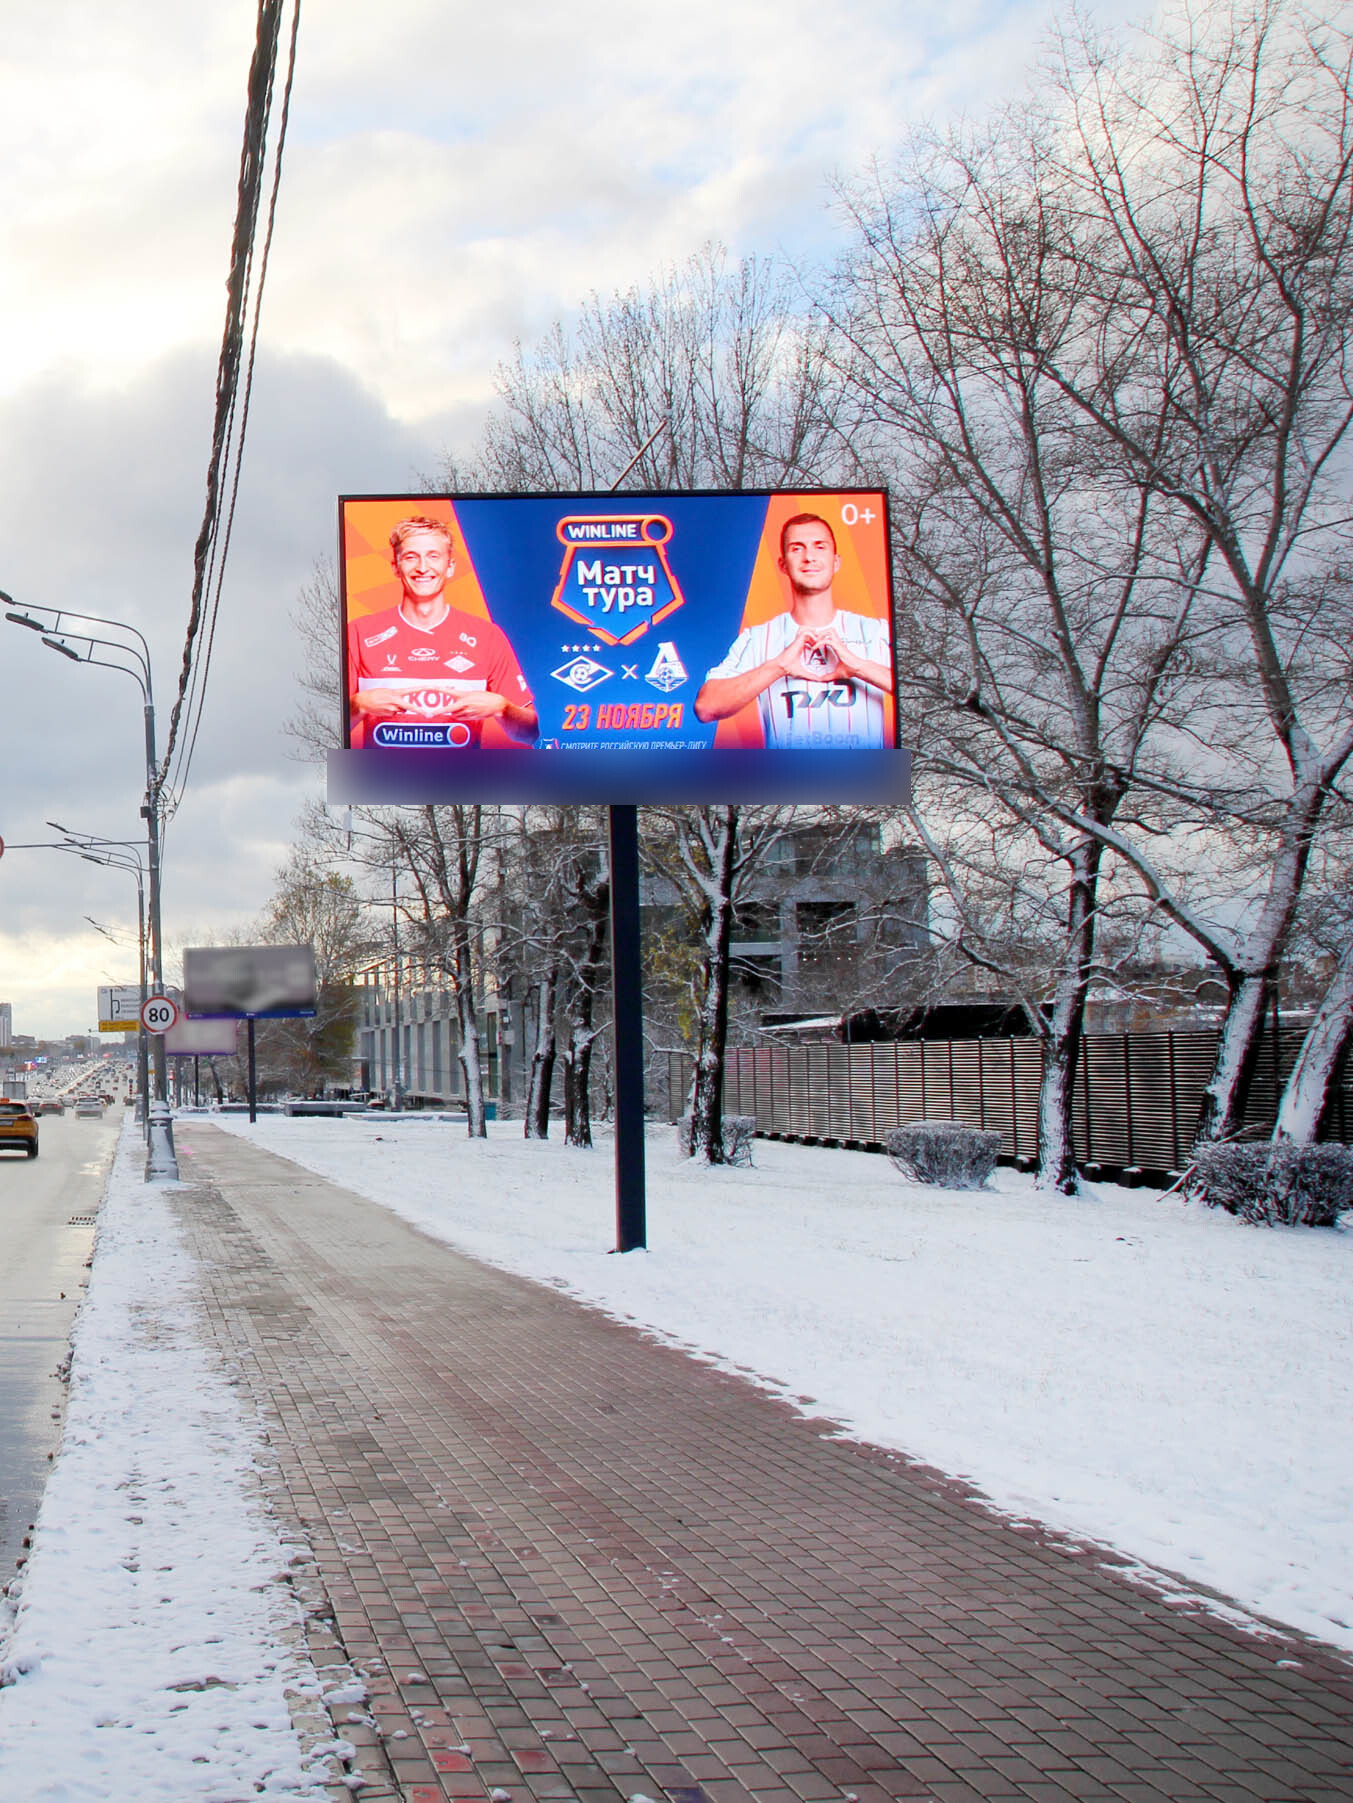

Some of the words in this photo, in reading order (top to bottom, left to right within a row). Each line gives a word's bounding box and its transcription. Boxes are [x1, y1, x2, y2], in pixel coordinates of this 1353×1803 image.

[842, 503, 876, 525] 0+
[568, 524, 637, 538] WINLINE
[577, 560, 656, 585] Матч
[582, 587, 654, 613] тура
[562, 703, 591, 731] 23
[596, 703, 684, 730] НОЯБРЯ
[382, 728, 444, 742] Winline
[149, 1007, 170, 1023] 80
